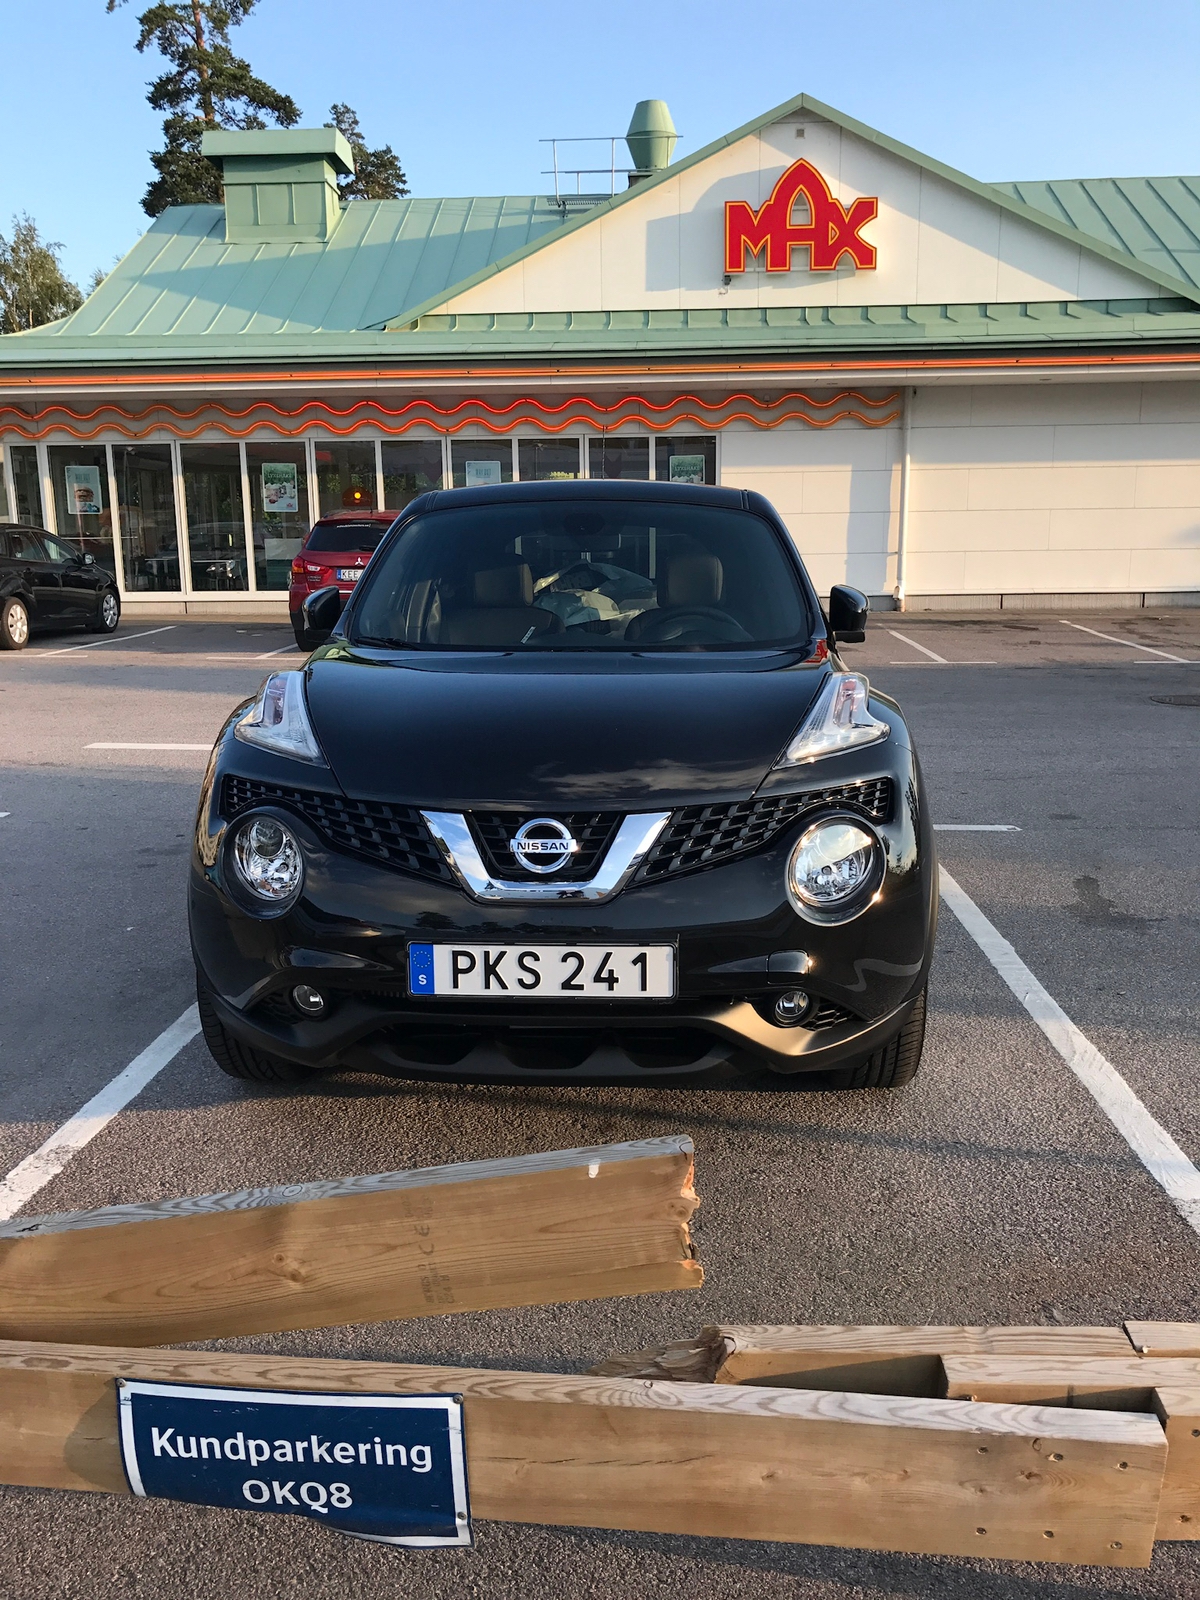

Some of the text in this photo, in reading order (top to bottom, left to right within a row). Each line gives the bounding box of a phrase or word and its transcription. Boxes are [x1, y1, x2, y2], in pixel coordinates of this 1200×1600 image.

[725, 158, 878, 273] MAX
[517, 842, 569, 851] NISSAN
[418, 974, 427, 985] S
[451, 950, 648, 992] PKS 241
[151, 1427, 433, 1473] Kundparkering
[242, 1479, 353, 1514] OKQ8
